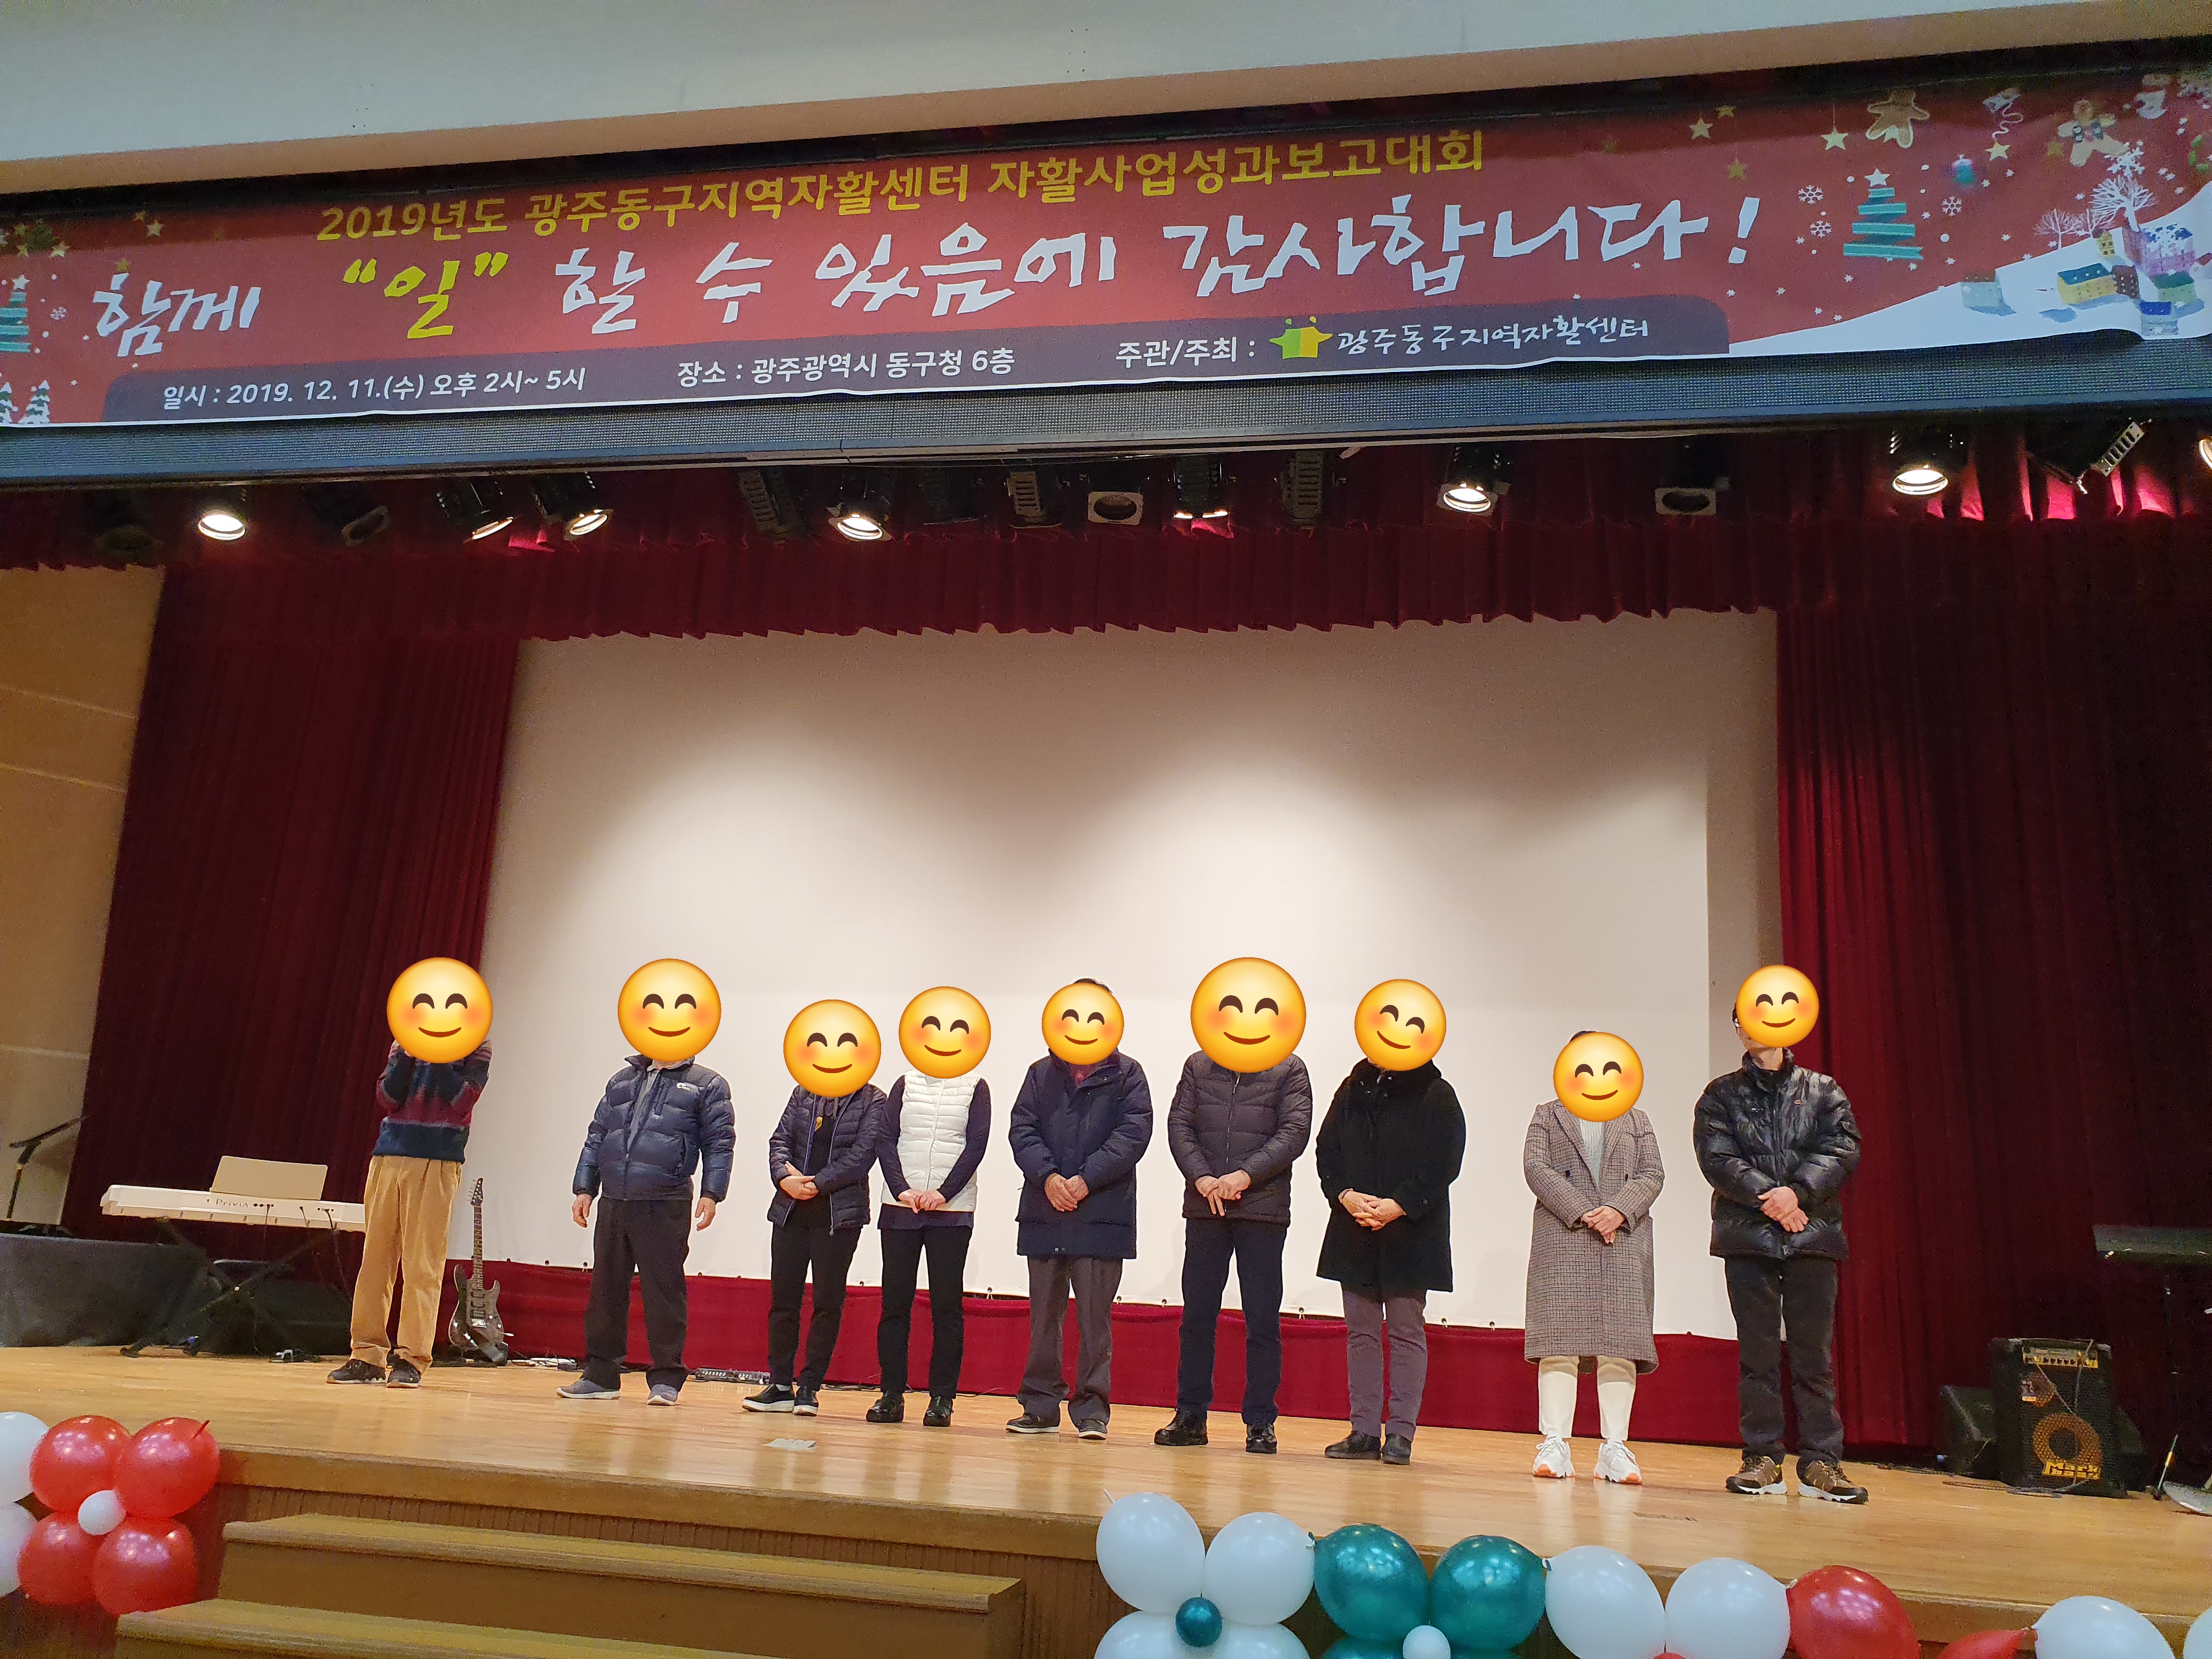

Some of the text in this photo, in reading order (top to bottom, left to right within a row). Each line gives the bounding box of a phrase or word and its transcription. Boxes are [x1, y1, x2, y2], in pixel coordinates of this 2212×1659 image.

[317, 131, 1482, 241] 2019년도 광주동구지역자활센터 자활사업성과보고대회
[93, 273, 261, 357] 함께
[555, 247, 646, 334] 할
[695, 241, 773, 324] 수
[815, 222, 1117, 317] 있음에
[677, 360, 726, 387] 장소
[751, 353, 877, 385] 광주광역시
[885, 349, 962, 378] 동구청
[972, 347, 1015, 375] 6층
[1115, 336, 1237, 369] 주관/주최
[1337, 315, 1648, 355] 광주동구지역자활센터
[163, 385, 206, 410] 일시
[226, 383, 293, 404] 2019.
[304, 380, 337, 400] 12.
[348, 374, 424, 402] 11.(수)
[430, 372, 477, 398] 오후
[545, 367, 586, 391] 5시
